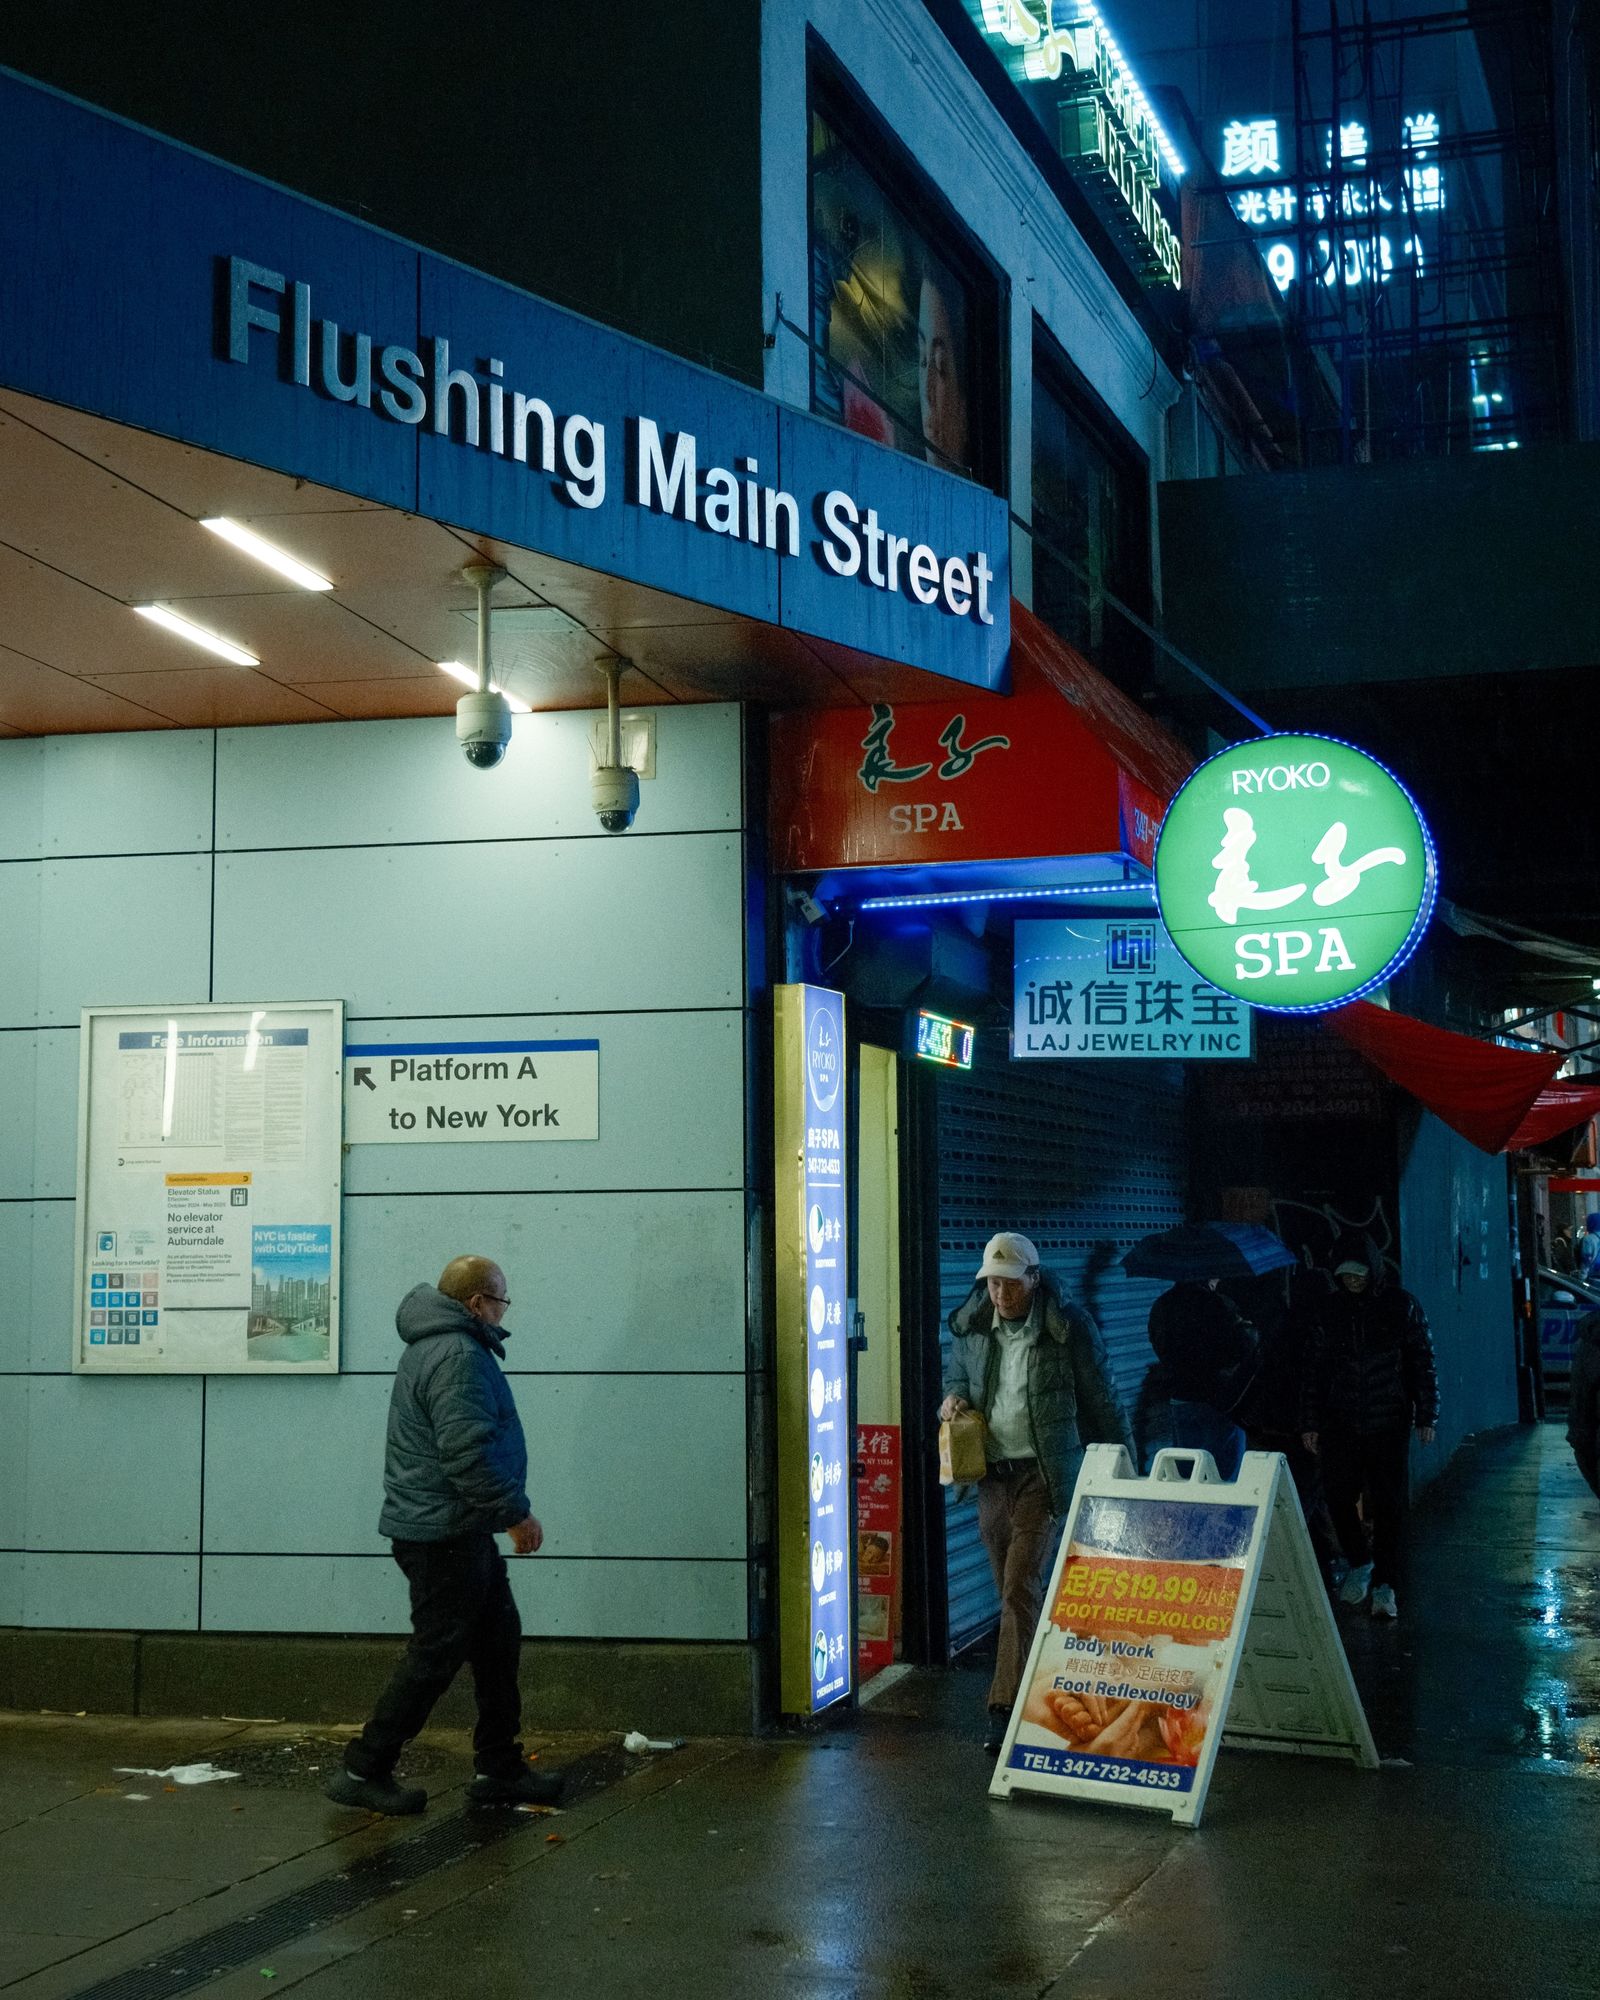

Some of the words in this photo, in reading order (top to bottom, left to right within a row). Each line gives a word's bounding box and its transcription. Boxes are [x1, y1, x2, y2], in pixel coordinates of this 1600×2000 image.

[228, 255, 605, 510] Flushing
[637, 415, 800, 557] Main
[823, 490, 995, 626] Street
[1231, 761, 1331, 795] RYOKO
[888, 802, 965, 835] SPA
[1134, 807, 1160, 844] 347-7
[1234, 928, 1357, 980] SPA
[1025, 980, 1240, 1025] 诚信珠宝
[151, 1034, 184, 1047] Fae
[188, 1033, 273, 1046] Informaton
[1027, 1033, 1070, 1051] LAJ
[1077, 1033, 1194, 1051] JEWELRY
[1201, 1033, 1241, 1051] INC
[390, 1057, 508, 1082] Platform
[517, 1056, 538, 1080] A
[812, 1050, 836, 1072] RYOKO
[389, 1108, 416, 1130] to
[426, 1105, 488, 1129] New
[496, 1104, 560, 1128] York
[168, 1188, 196, 1196] Elevator
[167, 1213, 182, 1222] No
[183, 1212, 223, 1222] elevator
[167, 1226, 203, 1234] service
[205, 1224, 215, 1233] at
[167, 1236, 225, 1246] Auburndale
[254, 1231, 277, 1241] NYC
[287, 1231, 317, 1241] faster
[254, 1243, 276, 1253] with
[1055, 1601, 1103, 1619] FOOT
[1104, 1607, 1232, 1632] REFLEXOLOGY
[1064, 1636, 1107, 1656] Body
[1111, 1642, 1155, 1659] Work
[1053, 1676, 1092, 1692] Foot
[1095, 1681, 1199, 1708] Reflexology
[1023, 1752, 1060, 1772] TEL:
[1062, 1758, 1181, 1788] 347-732-4533
